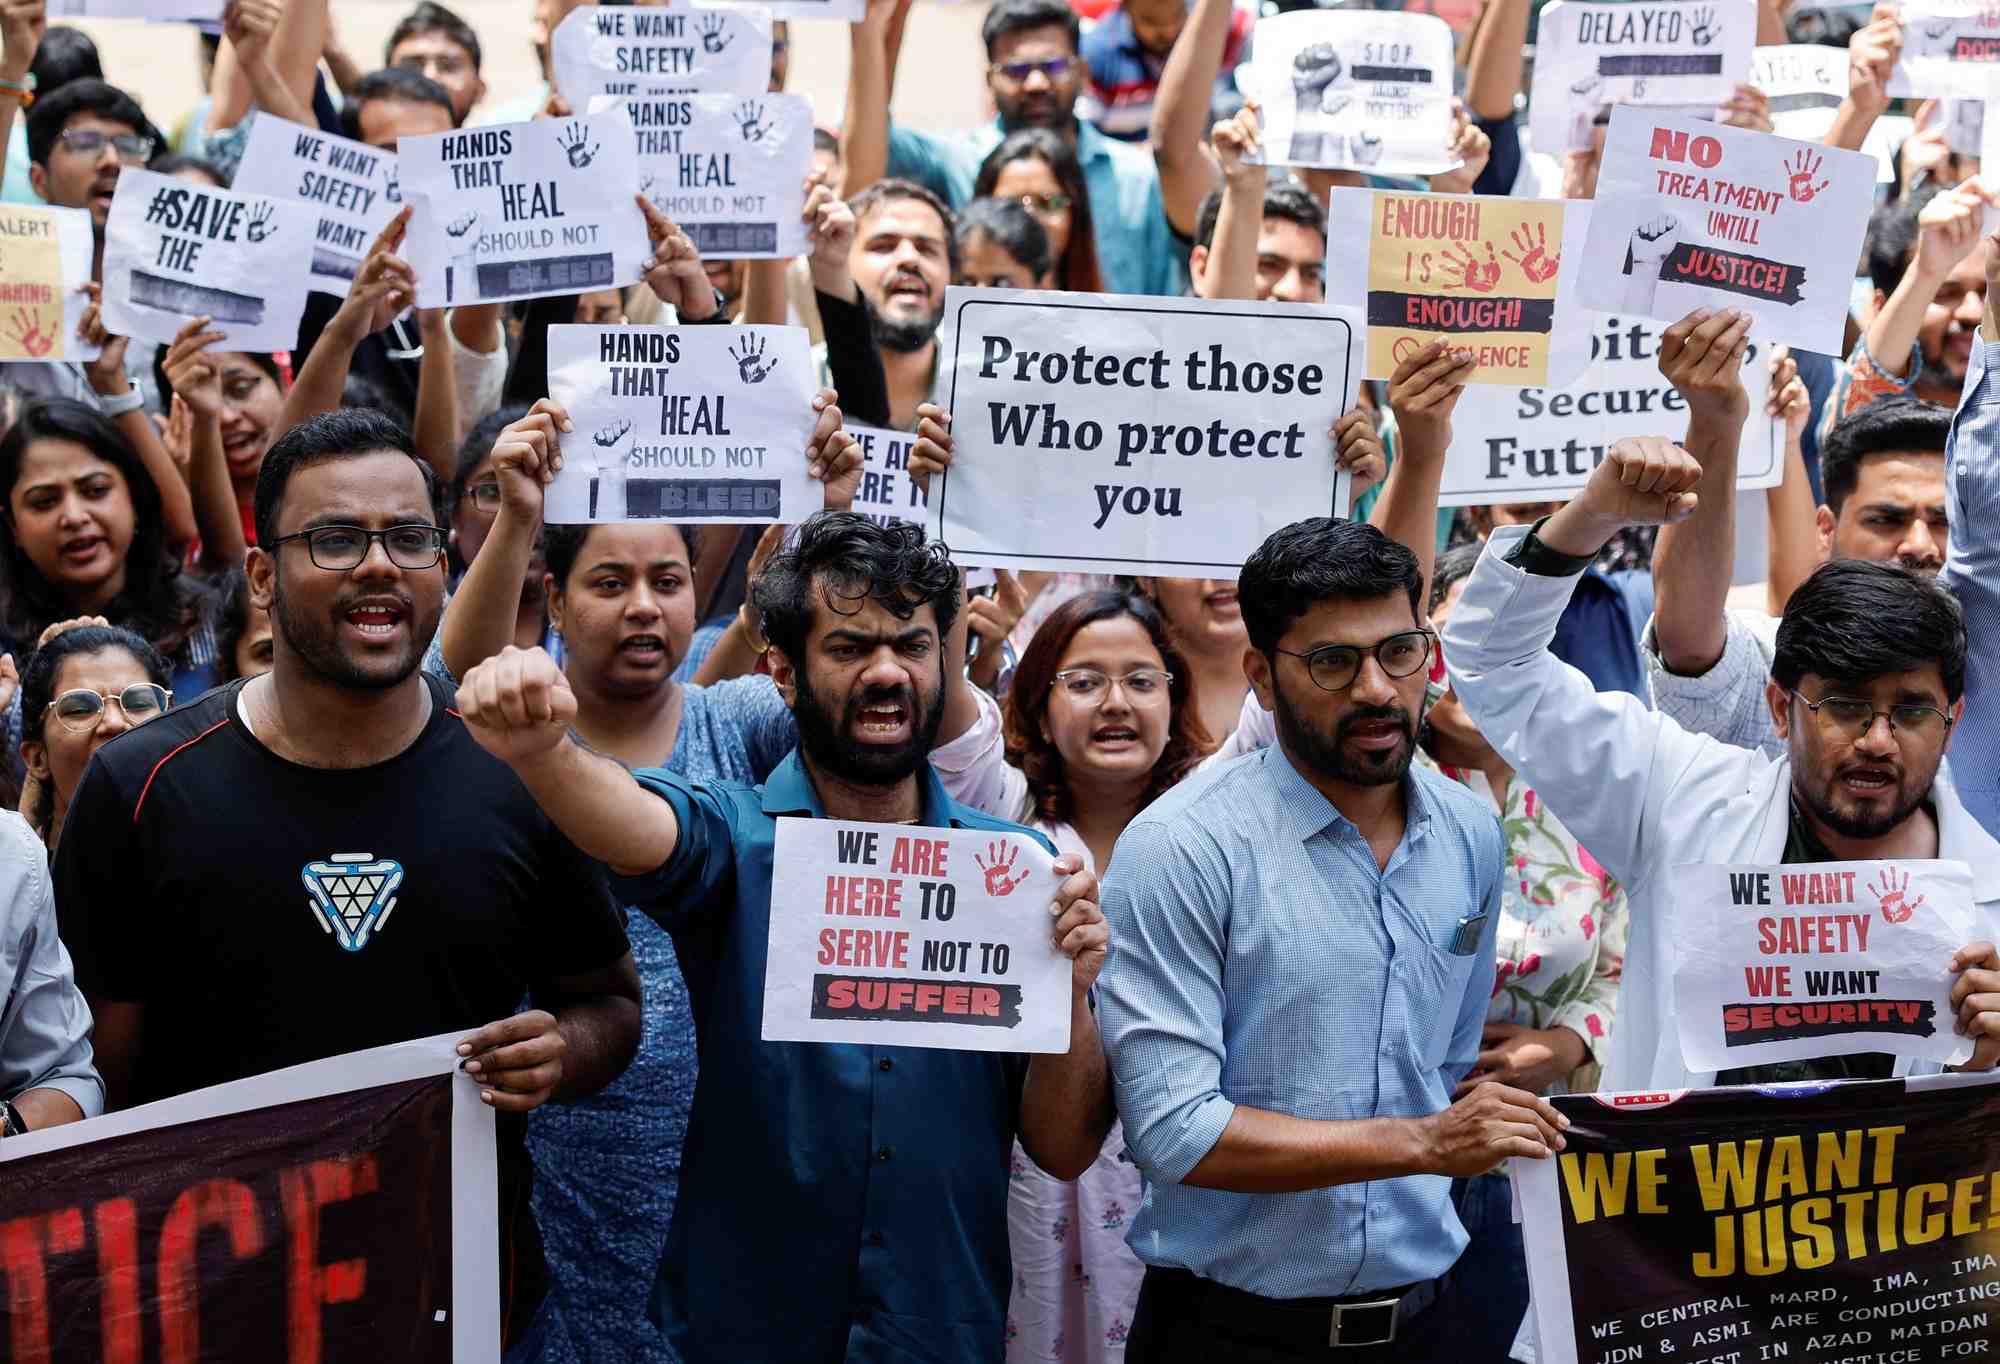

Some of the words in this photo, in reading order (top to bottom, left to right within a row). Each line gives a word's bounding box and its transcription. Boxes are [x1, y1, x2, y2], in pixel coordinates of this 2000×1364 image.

[598, 15, 625, 37] WE
[634, 15, 687, 38] WANT
[1578, 11, 1682, 44] DELAYED
[616, 47, 696, 73] SAFETY
[1364, 43, 1414, 63] STOP
[1633, 79, 1647, 99] IS
[628, 102, 692, 126] HANDS
[294, 133, 325, 162] WE
[327, 145, 379, 178] WANT
[441, 129, 513, 161] HANDS
[635, 131, 684, 154] THAT
[1649, 127, 1722, 169] NO
[450, 160, 503, 189] THAT
[679, 153, 736, 188] HEAL
[298, 171, 377, 216] SAFETY
[500, 181, 565, 222] HEAL
[655, 195, 725, 214] SHOULD
[732, 195, 767, 214] NOT
[1656, 170, 1784, 215] TREATMENT
[145, 187, 246, 243] #SAVE
[1382, 198, 1481, 242] ENOUGH
[1707, 210, 1760, 245] UNTILL
[316, 218, 368, 251] WANT
[479, 228, 554, 254] SHOULD
[562, 224, 600, 244] NOT
[155, 234, 203, 274] THE
[1405, 251, 1432, 283] IS
[1677, 250, 1789, 294] JUSTICE!
[1406, 297, 1521, 328] ENOUGH!
[600, 333, 680, 363] HANDS
[978, 335, 1170, 390] Protect
[1184, 343, 1324, 396] those
[609, 367, 669, 397] THAT
[660, 395, 731, 436] HEAL
[1518, 387, 1685, 419] Secure
[987, 400, 1103, 452] Who
[1114, 418, 1305, 468] protect
[631, 446, 716, 469] SHOULD
[725, 447, 767, 468] NOT
[660, 485, 778, 511] BLEED
[1093, 482, 1183, 530] you
[838, 830, 879, 865] WE
[890, 836, 949, 877] ARE
[824, 875, 903, 918] HERE
[919, 881, 956, 921] TO
[1729, 872, 1771, 905] WE
[1780, 872, 1857, 905] WANT
[817, 928, 910, 969] SERVE
[921, 939, 972, 974] NOT
[980, 942, 1010, 975] TO
[1758, 914, 1871, 955] SAFETY
[826, 979, 1001, 1017] SUFFER
[1744, 966, 1793, 997] WE
[1805, 970, 1880, 997] WANT
[1724, 1002, 1921, 1032] SECURITY
[1560, 1148, 1668, 1224] WE
[1689, 1125, 1905, 1212] WANT
[1692, 1170, 2000, 1278] JUSTICE!
[1591, 1319, 1624, 1339] WE
[1640, 1294, 1750, 1329] CENTRAL
[1770, 1287, 1849, 1304] MARD,
[1872, 1271, 1929, 1294] IMA,
[1951, 1253, 1997, 1276] IMA
[1597, 1345, 1643, 1364] JDN
[1660, 1338, 1676, 1354] &
[1692, 1320, 1753, 1347] ASMI
[1770, 1312, 1819, 1330] ARE
[1838, 1280, 2000, 1322] CONDUCTING
[1759, 1341, 1789, 1361] IN
[1805, 1330, 1872, 1352] AZAD
[1890, 1312, 1988, 1341] MAIDAN
[1941, 1338, 1989, 1358] FOR
